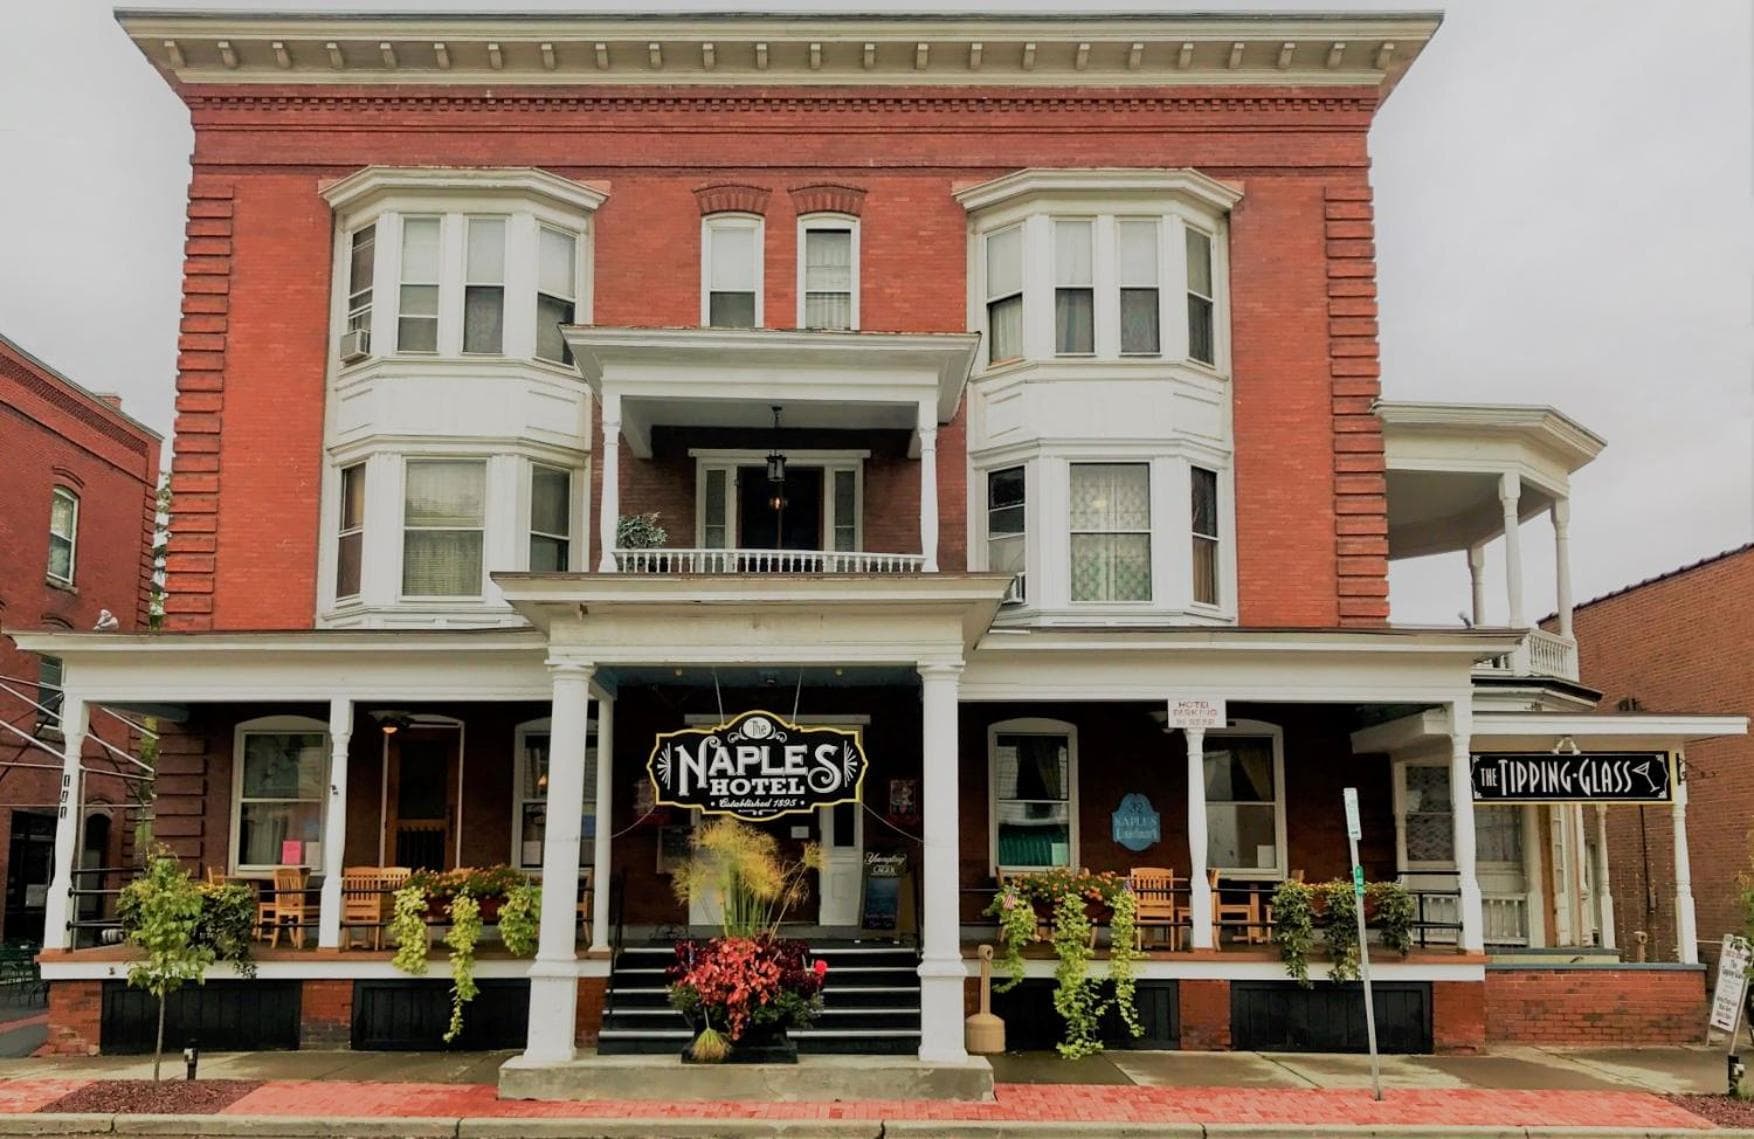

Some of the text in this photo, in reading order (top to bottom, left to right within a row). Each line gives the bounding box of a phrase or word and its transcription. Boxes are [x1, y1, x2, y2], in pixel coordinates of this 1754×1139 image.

[1178, 700, 1209, 709] HOTEL
[752, 719, 767, 735] The
[674, 735, 842, 797] NAPLES
[1480, 767, 1498, 787] THE
[709, 778, 806, 796] HOTEL
[719, 797, 773, 808] Established
